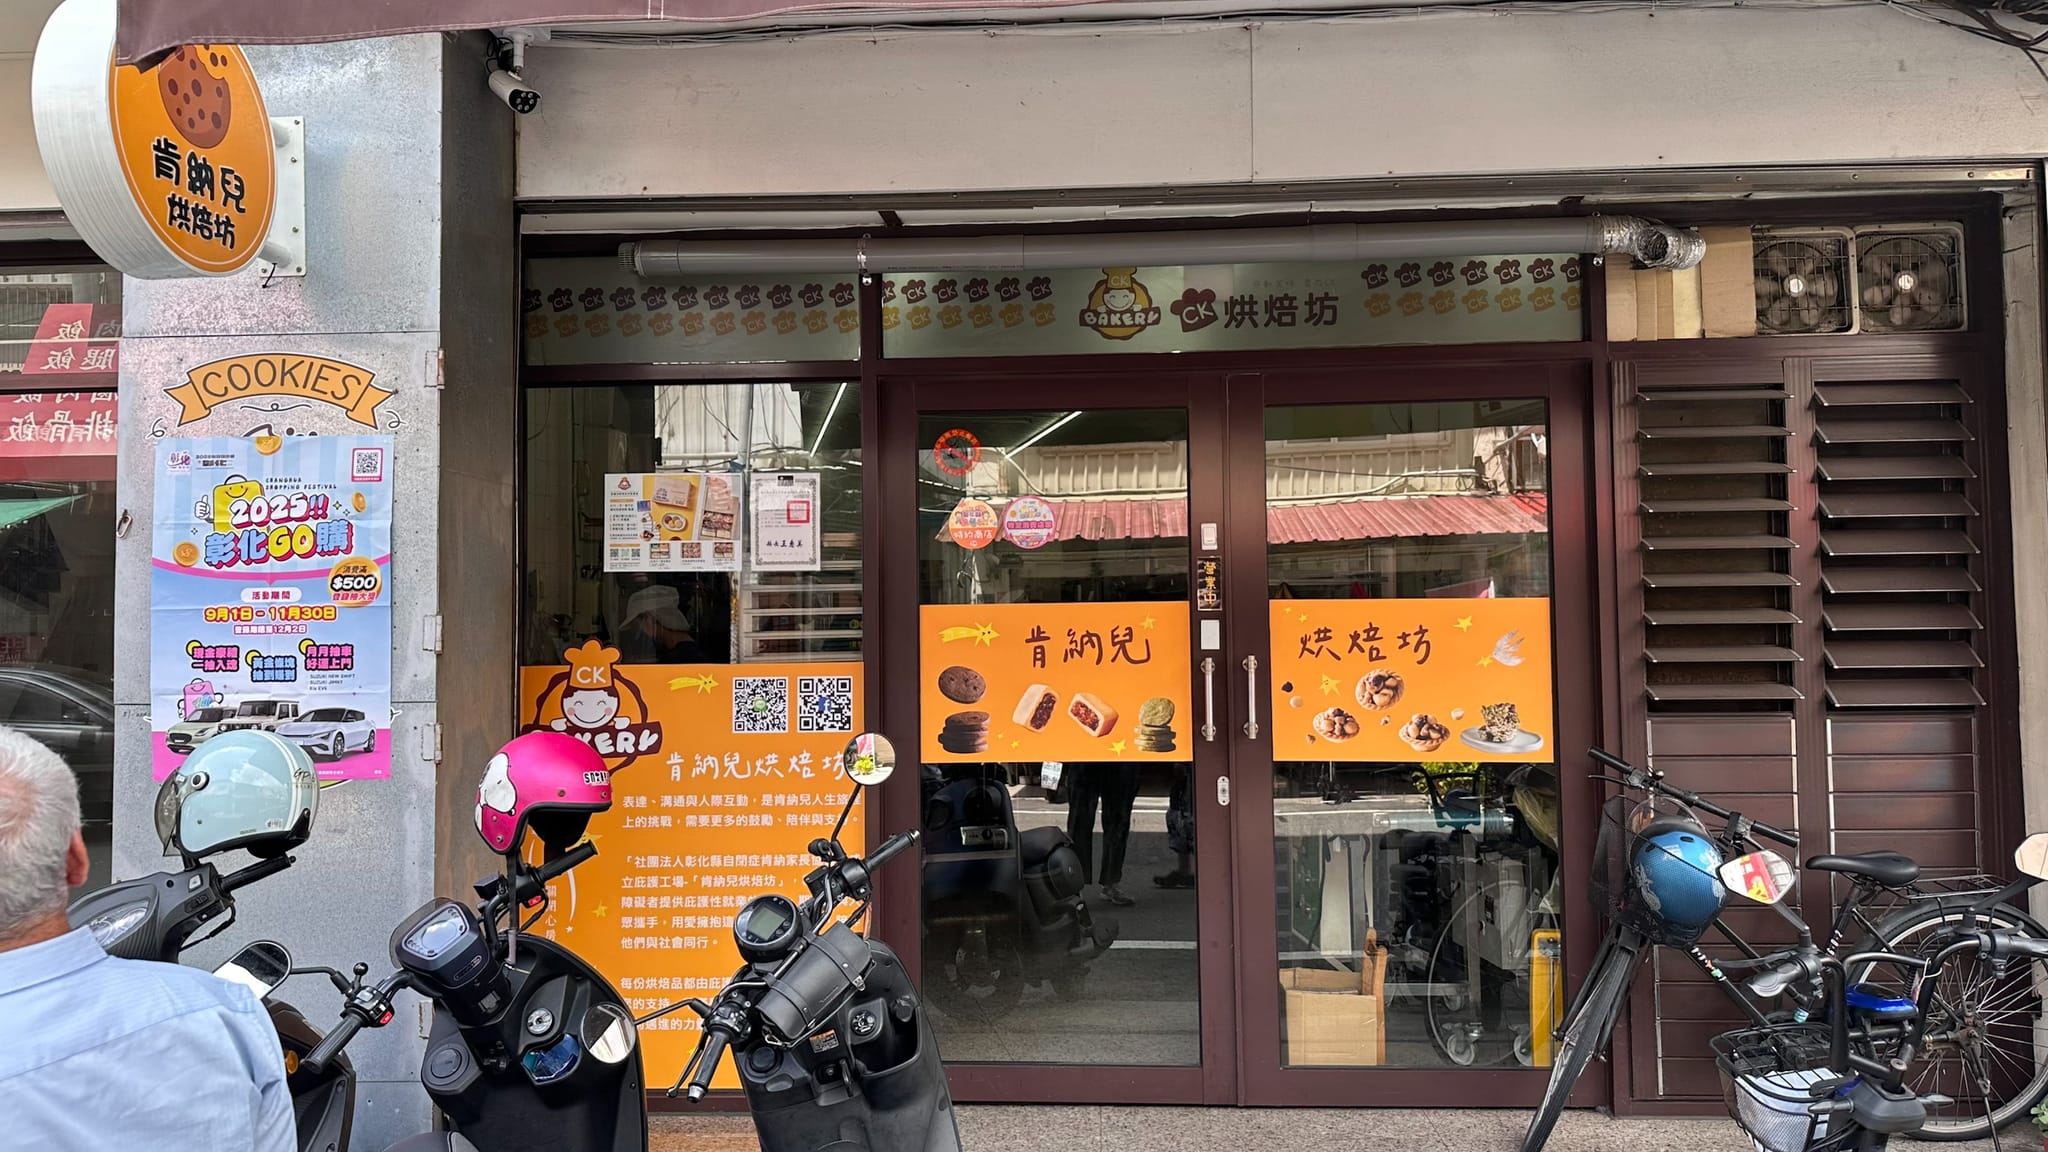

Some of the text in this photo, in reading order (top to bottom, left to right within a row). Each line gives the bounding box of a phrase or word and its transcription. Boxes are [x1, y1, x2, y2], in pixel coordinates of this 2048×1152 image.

[151, 136, 246, 214] 肯納兒
[167, 193, 236, 250] 烘焙坊
[1110, 276, 1128, 286] CK
[1084, 311, 1160, 326] BAKERY
[1182, 301, 1214, 324] CK
[1224, 292, 1339, 328] 烘焙坊
[202, 358, 362, 401] COOKIES
[229, 492, 330, 529] 2025!!
[204, 519, 354, 568] 彰化GO購
[251, 591, 291, 600] 活動期間
[331, 576, 377, 591] $500
[1203, 560, 1218, 605] 營業中
[204, 606, 254, 622] 9月1日
[268, 606, 338, 621] 11月30日
[1025, 624, 1152, 669] 肯納兒
[1297, 621, 1432, 665] 烘焙坊
[576, 666, 607, 685] CK
